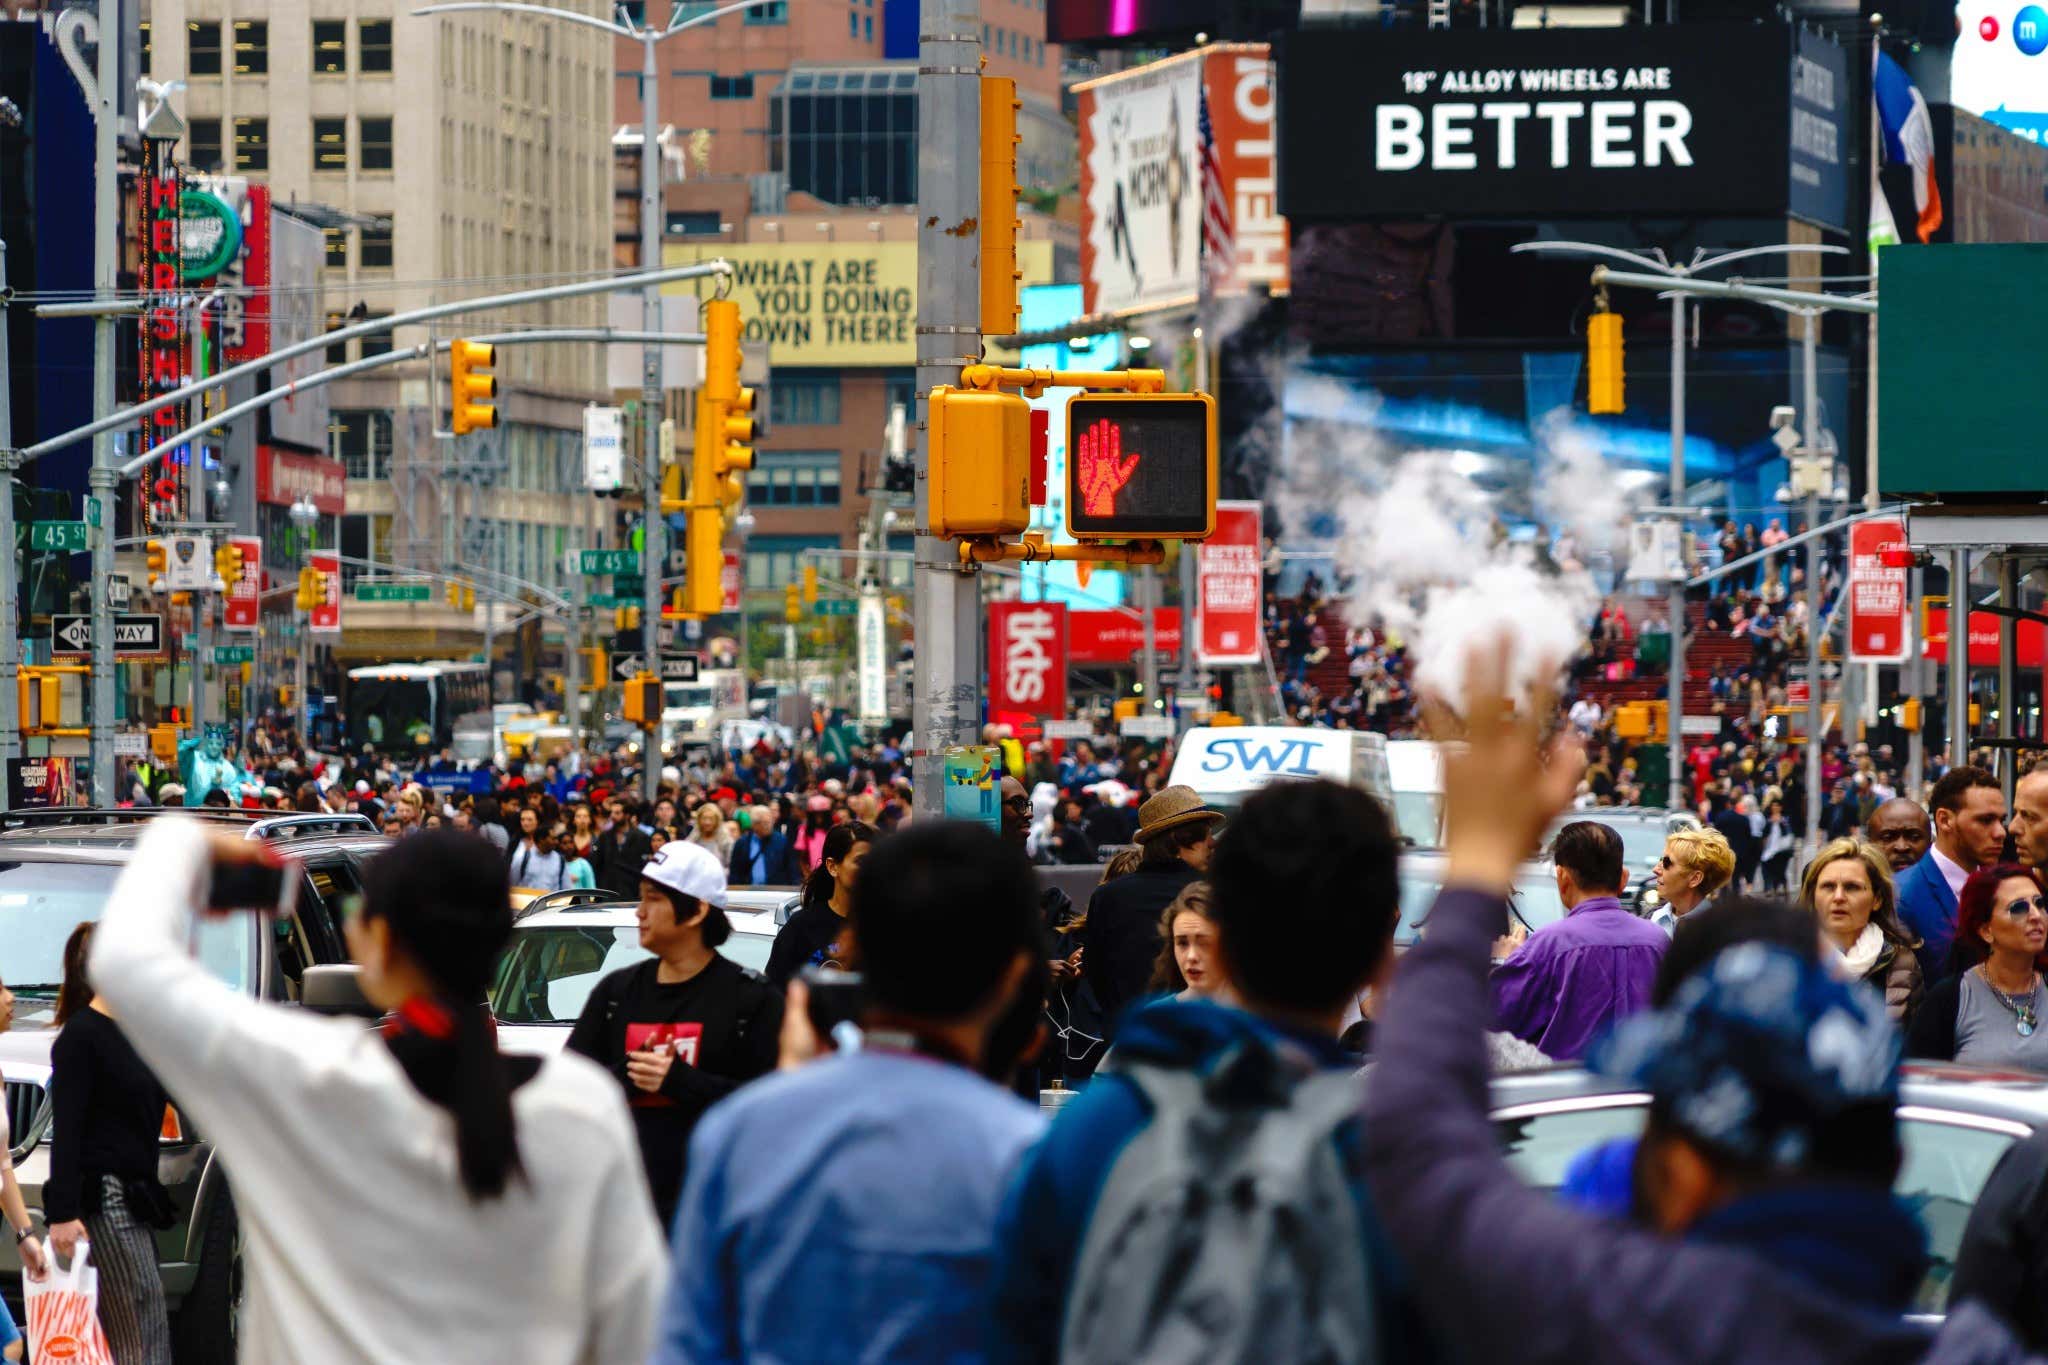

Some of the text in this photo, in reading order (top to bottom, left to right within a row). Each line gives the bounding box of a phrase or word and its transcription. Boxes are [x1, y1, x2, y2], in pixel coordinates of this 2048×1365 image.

[2019, 21, 2036, 40] m
[1440, 70, 1516, 94] ALLOY
[1519, 69, 1619, 92] WHEELS
[1622, 67, 1672, 91] ARE
[1374, 100, 1695, 171] BETTER
[824, 259, 879, 285] ARE
[754, 287, 912, 315] YOU DOING
[45, 525, 66, 547] 45
[583, 554, 598, 571] W
[603, 552, 623, 571] 45
[70, 626, 146, 640] ON WAY
[1006, 607, 1056, 703] tkts
[1201, 738, 1324, 776] SWI
